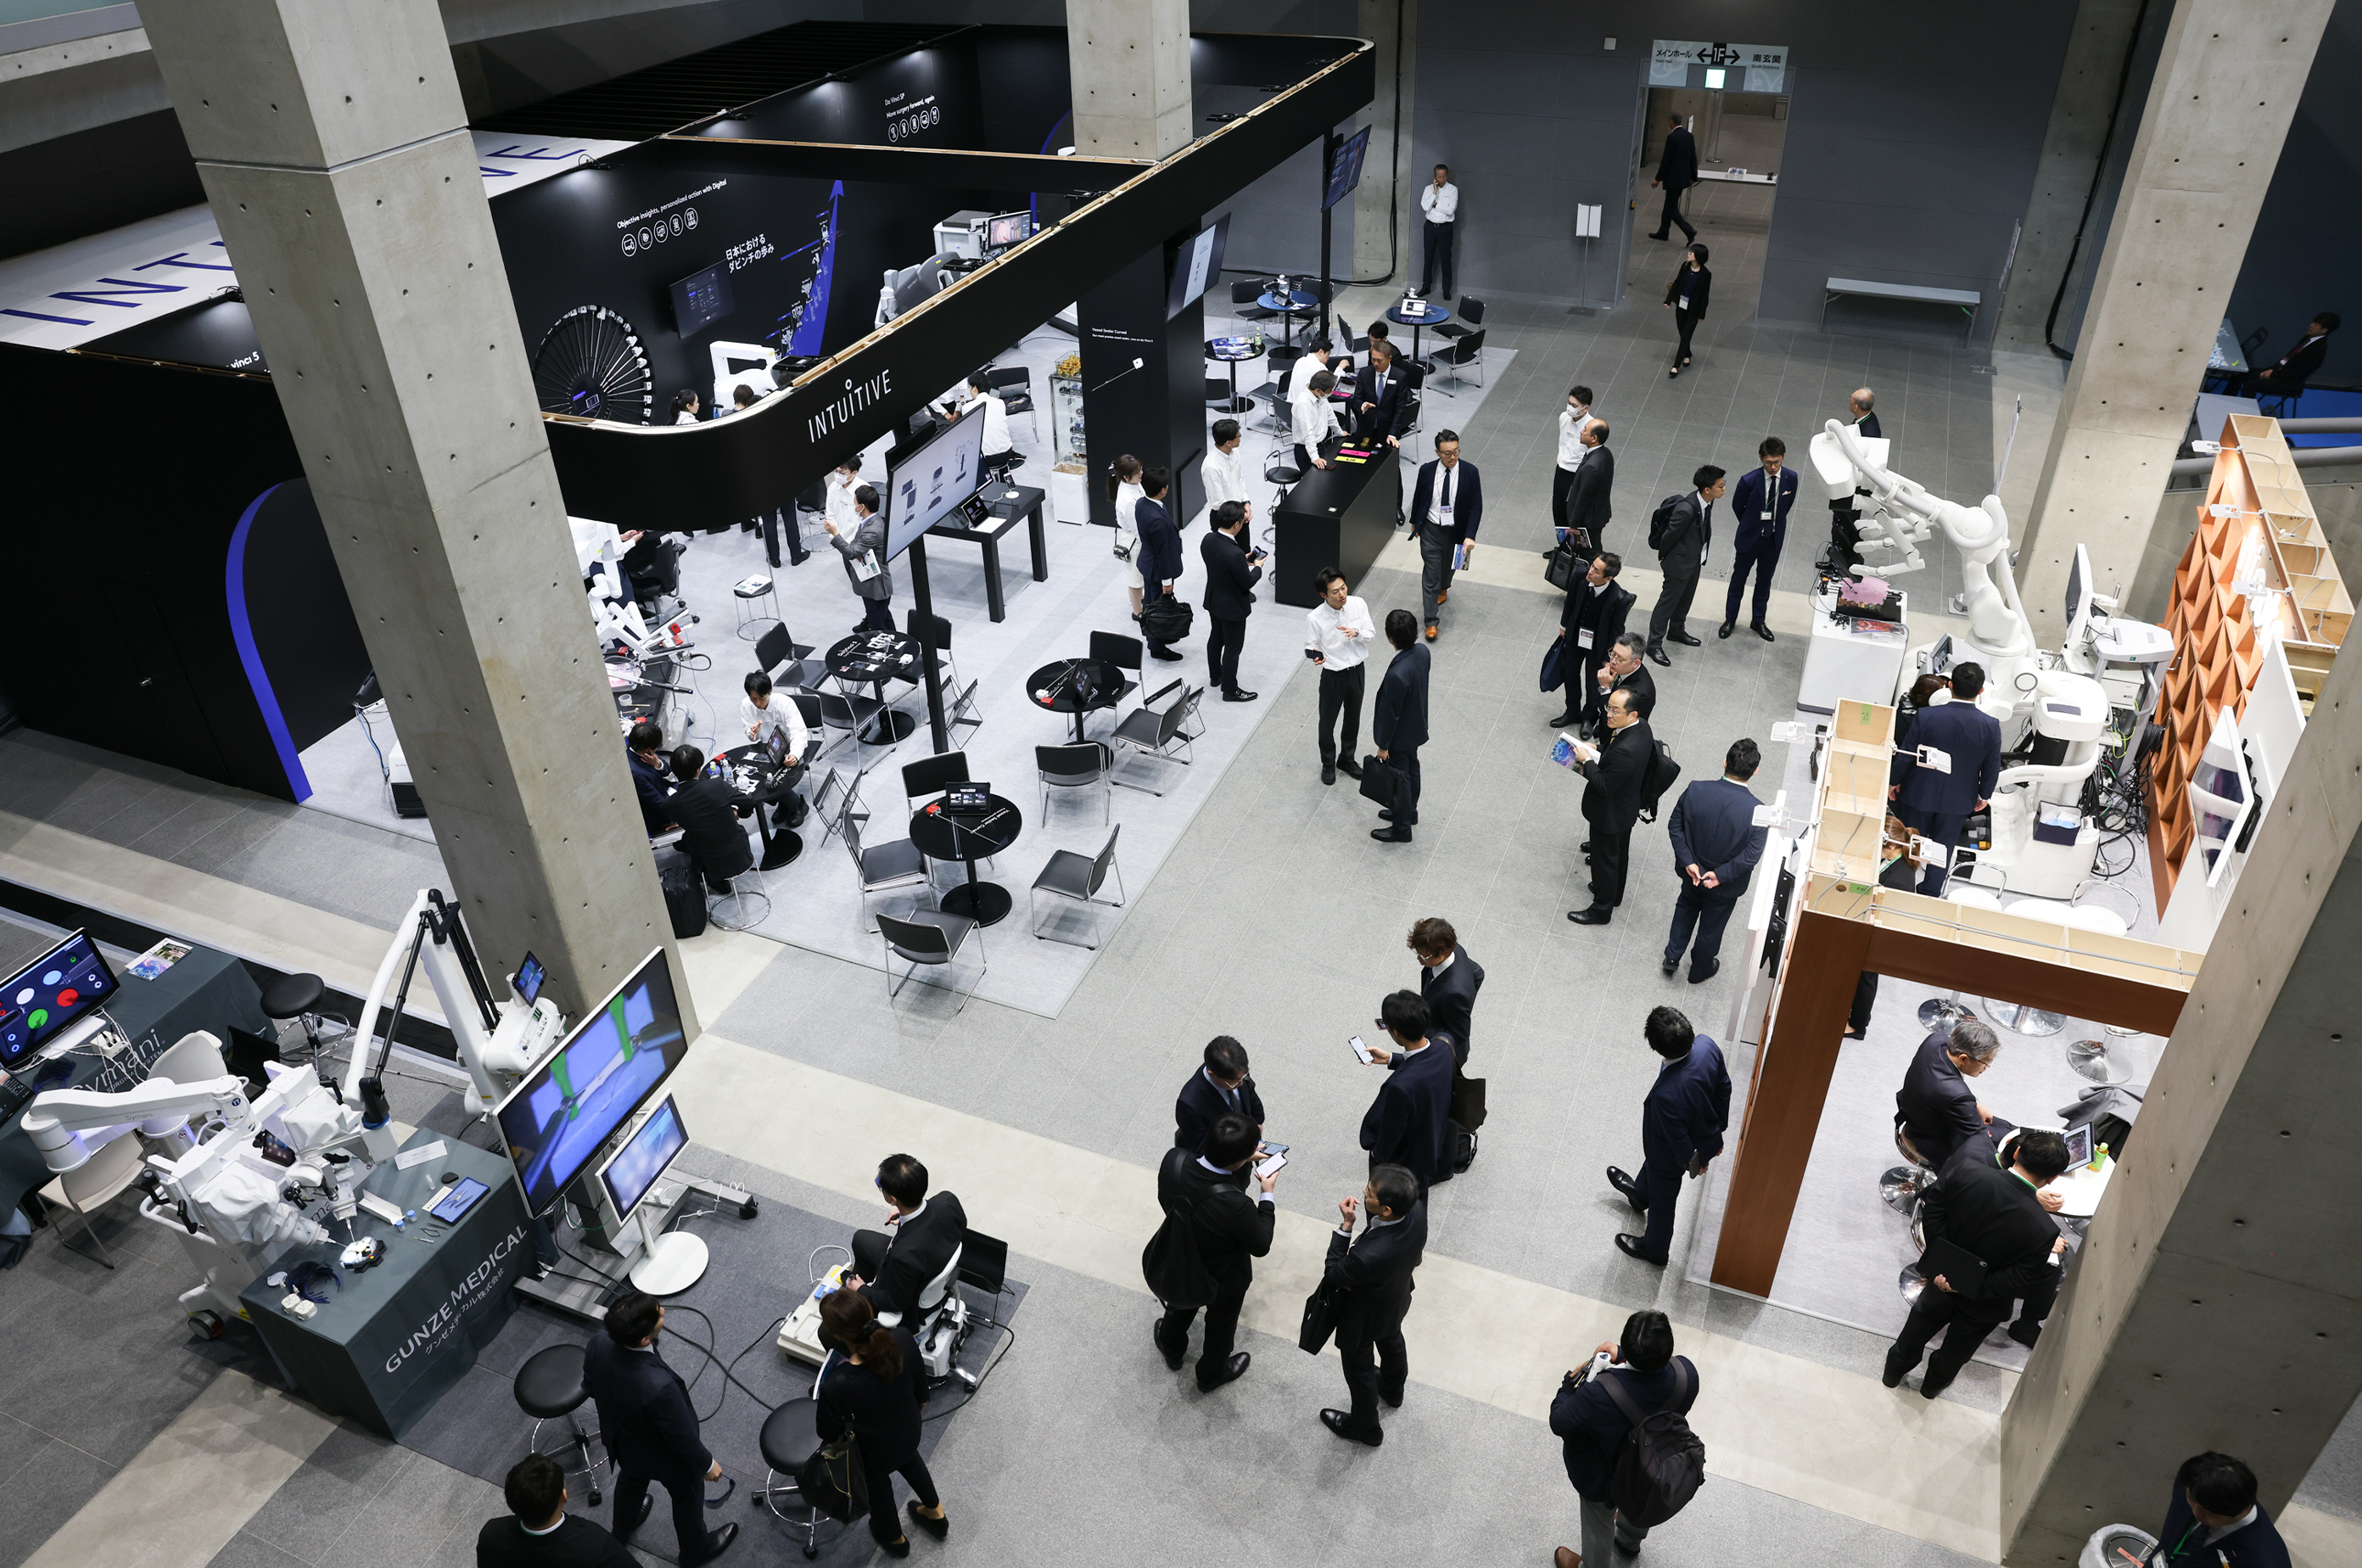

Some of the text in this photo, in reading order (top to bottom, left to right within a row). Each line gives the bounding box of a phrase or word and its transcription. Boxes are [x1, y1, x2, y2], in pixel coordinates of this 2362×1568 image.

[1656, 49, 1693, 59] メインホール
[1713, 48, 1725, 63] 1F
[1753, 53, 1782, 64] 南玄関
[617, 178, 727, 229] Objective insights, personalized action with Digital
[725, 233, 766, 260] 日本における
[728, 243, 775, 274] ダビンチの歩み
[252, 350, 260, 361] 5
[808, 368, 893, 443] INTUITIVE
[125, 1112, 154, 1122] Symani
[385, 1225, 528, 1374] GUNZE MEDICAL
